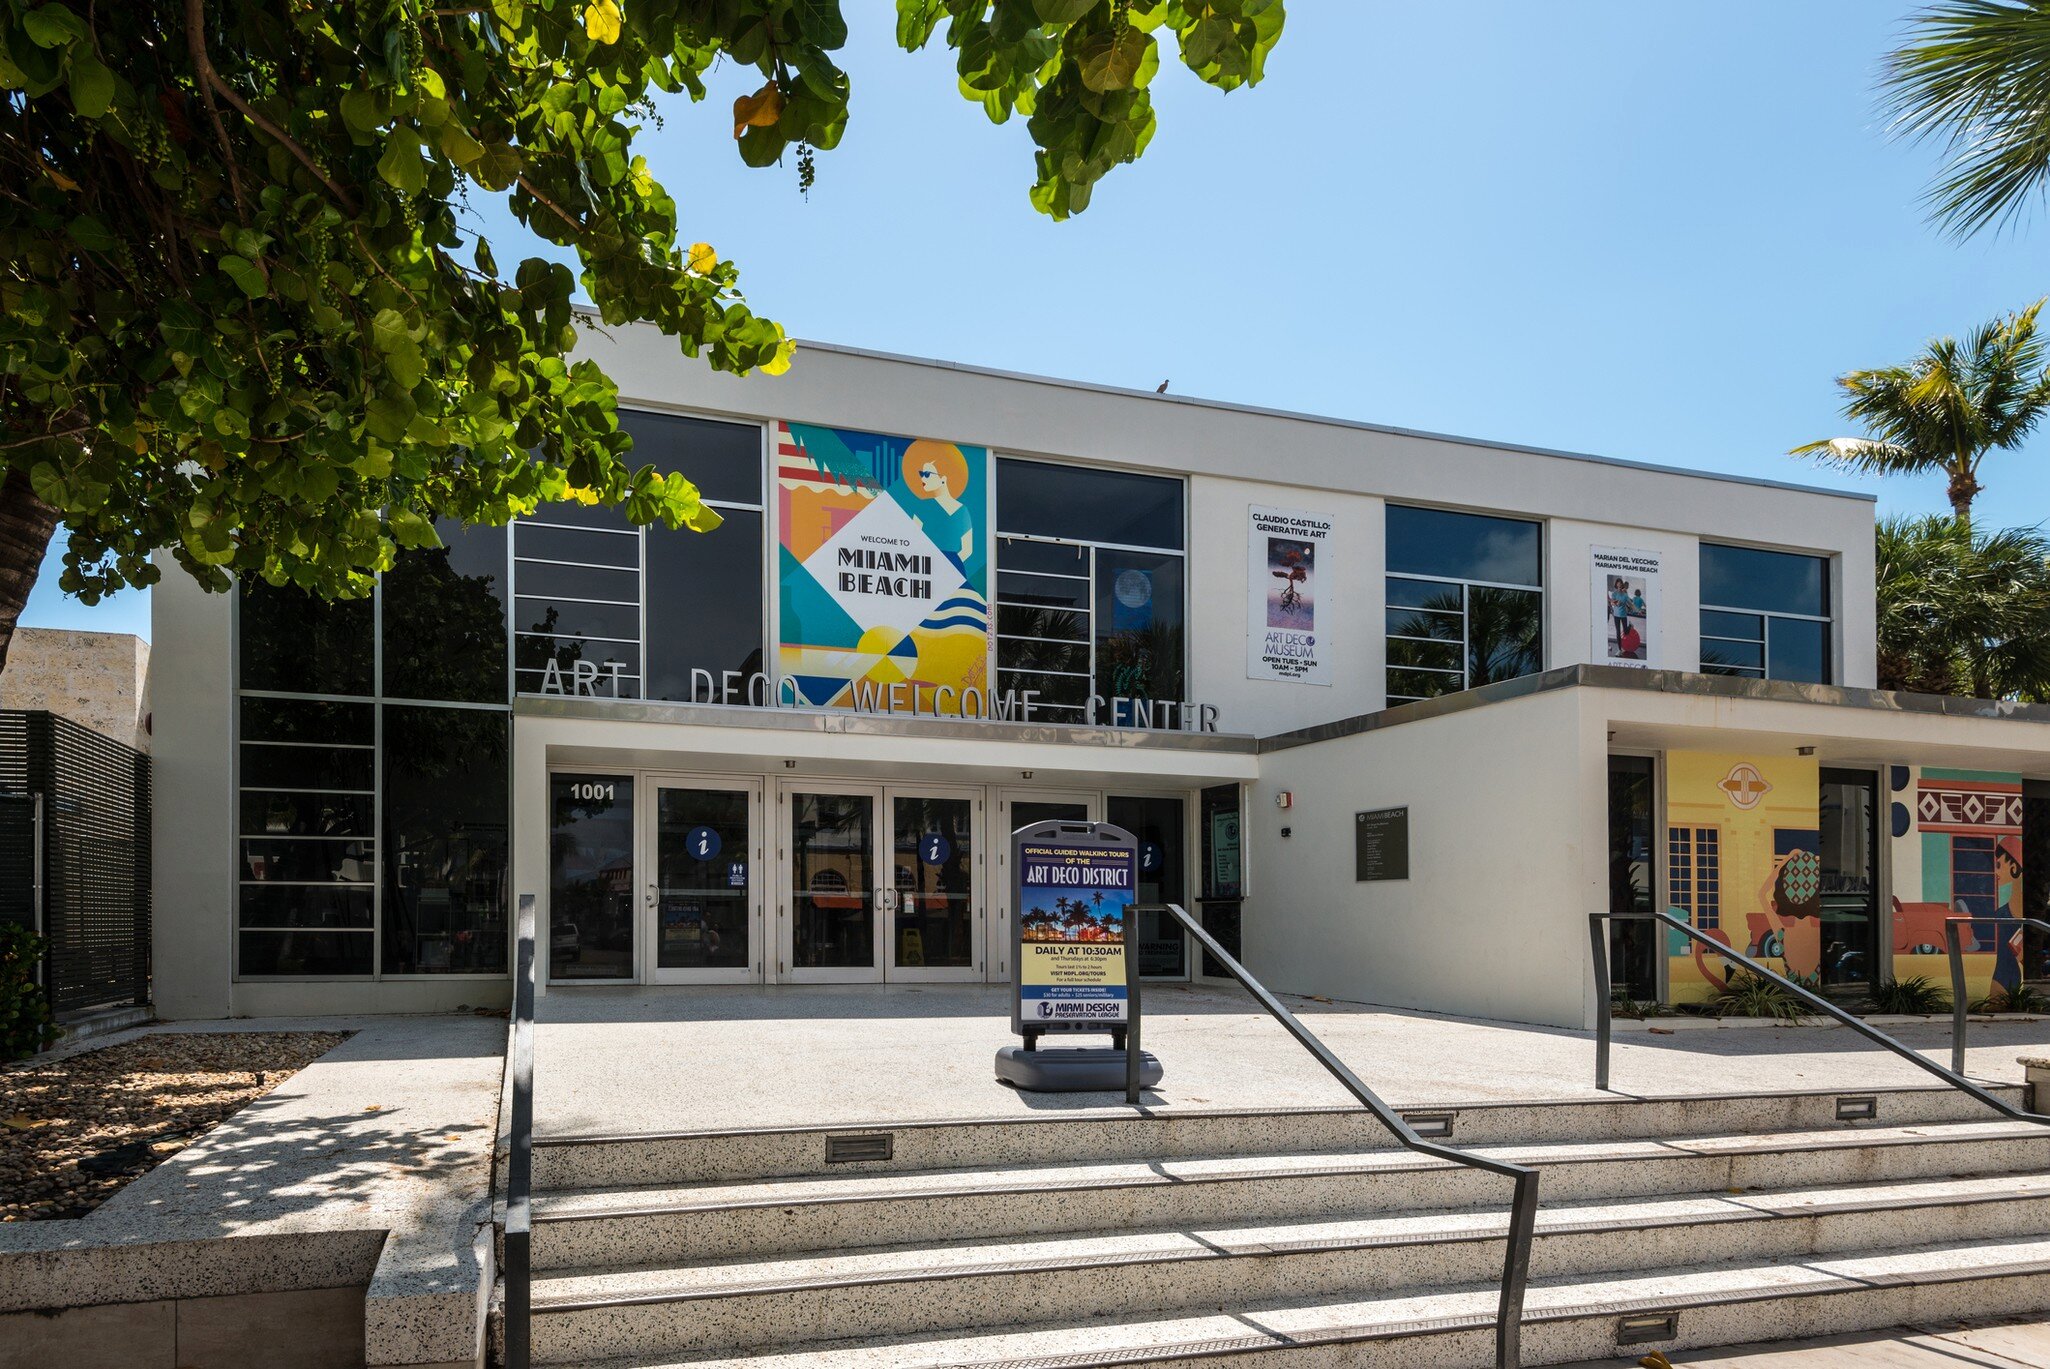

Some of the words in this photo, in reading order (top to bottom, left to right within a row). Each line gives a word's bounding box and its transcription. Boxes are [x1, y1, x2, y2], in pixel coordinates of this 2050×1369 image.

[1253, 514, 1288, 524] CLAUDIO
[1290, 519, 1330, 530] CASTILLO:
[1257, 524, 1308, 536] GENERATIVE
[861, 535, 897, 545] WELCOME
[838, 548, 931, 574] MIAMI
[839, 572, 931, 599] BEACH
[1265, 632, 1284, 643] ART
[1265, 644, 1313, 658] MUSEUM
[541, 658, 627, 698] ART
[691, 668, 800, 709] DECO
[850, 681, 1040, 723] WELCOME
[1084, 694, 1220, 732] CENTER
[571, 784, 614, 800] 1001
[1027, 866, 1048, 883] ART
[1052, 867, 1079, 884] DECO
[1083, 867, 1128, 886] DISTRICT
[1036, 946, 1065, 955] DAILY
[1067, 947, 1080, 955] AT
[1082, 947, 1121, 955] 10:30AM
[1056, 1003, 1084, 1012] MIAMI
[1086, 1003, 1119, 1012] DESIGN
